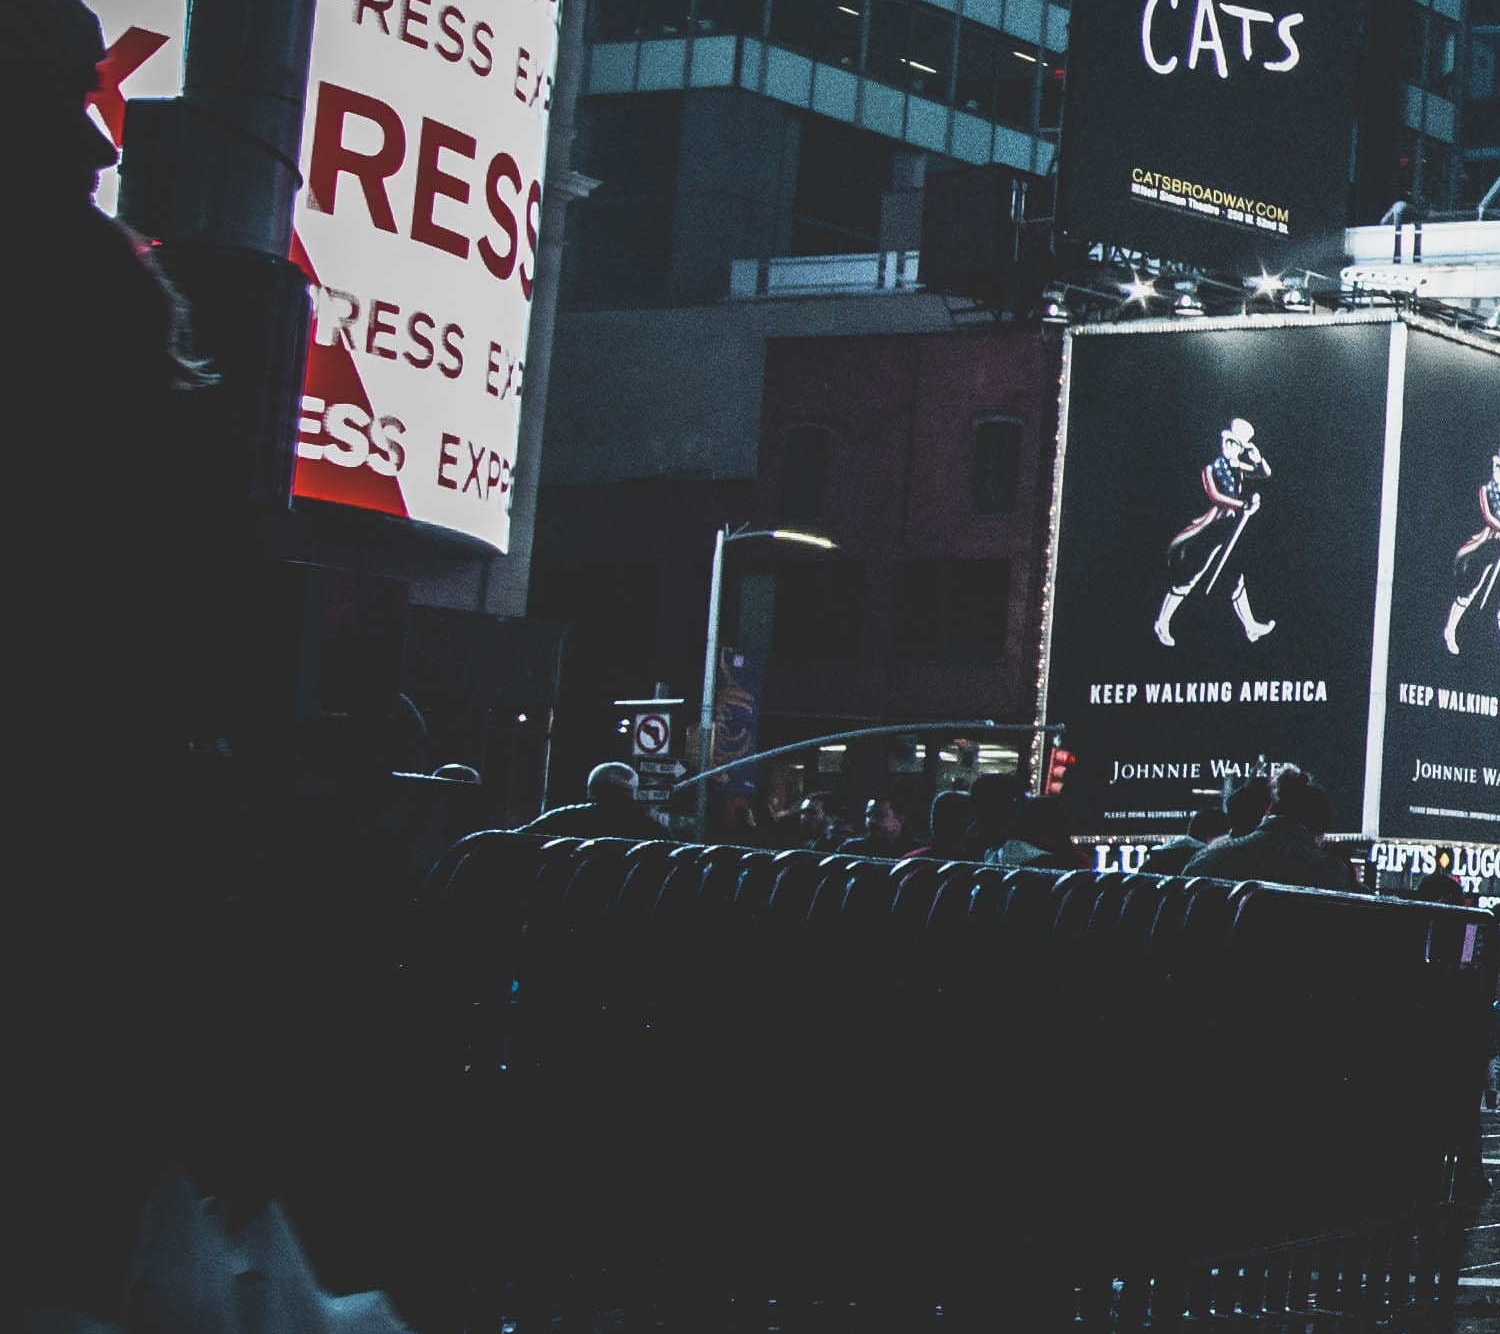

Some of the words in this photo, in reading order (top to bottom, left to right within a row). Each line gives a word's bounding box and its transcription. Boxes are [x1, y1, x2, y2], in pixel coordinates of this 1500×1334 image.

[1132, 168, 1289, 222] CATSBROADWAY.COM
[1090, 684, 1138, 704] KEEP
[1145, 682, 1233, 703] WALKING
[1239, 681, 1328, 702] AMERICA
[1400, 683, 1433, 709] KEEP
[1438, 689, 1498, 717] WALKING
[1371, 844, 1437, 875] GIFTS
